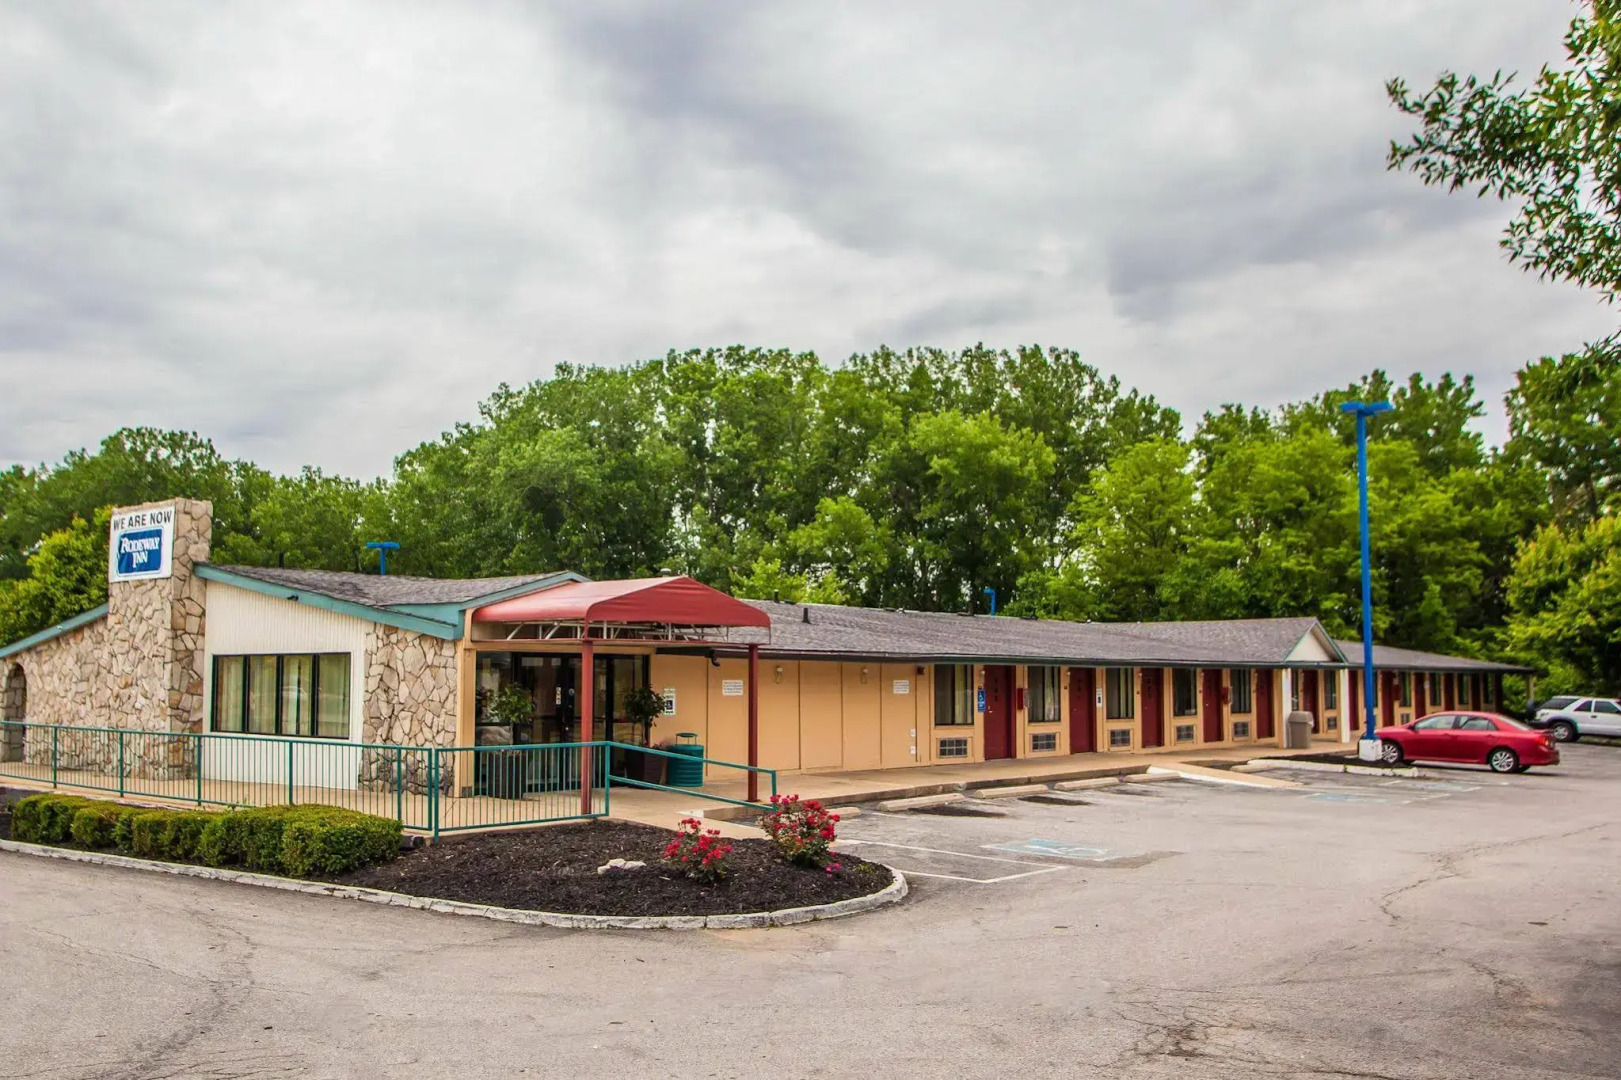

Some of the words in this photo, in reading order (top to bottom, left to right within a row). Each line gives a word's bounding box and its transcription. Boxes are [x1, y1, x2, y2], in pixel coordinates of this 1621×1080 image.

[113, 518, 126, 531] WE
[128, 514, 147, 527] ARE
[150, 511, 172, 525] NOW
[132, 551, 148, 568] INN
